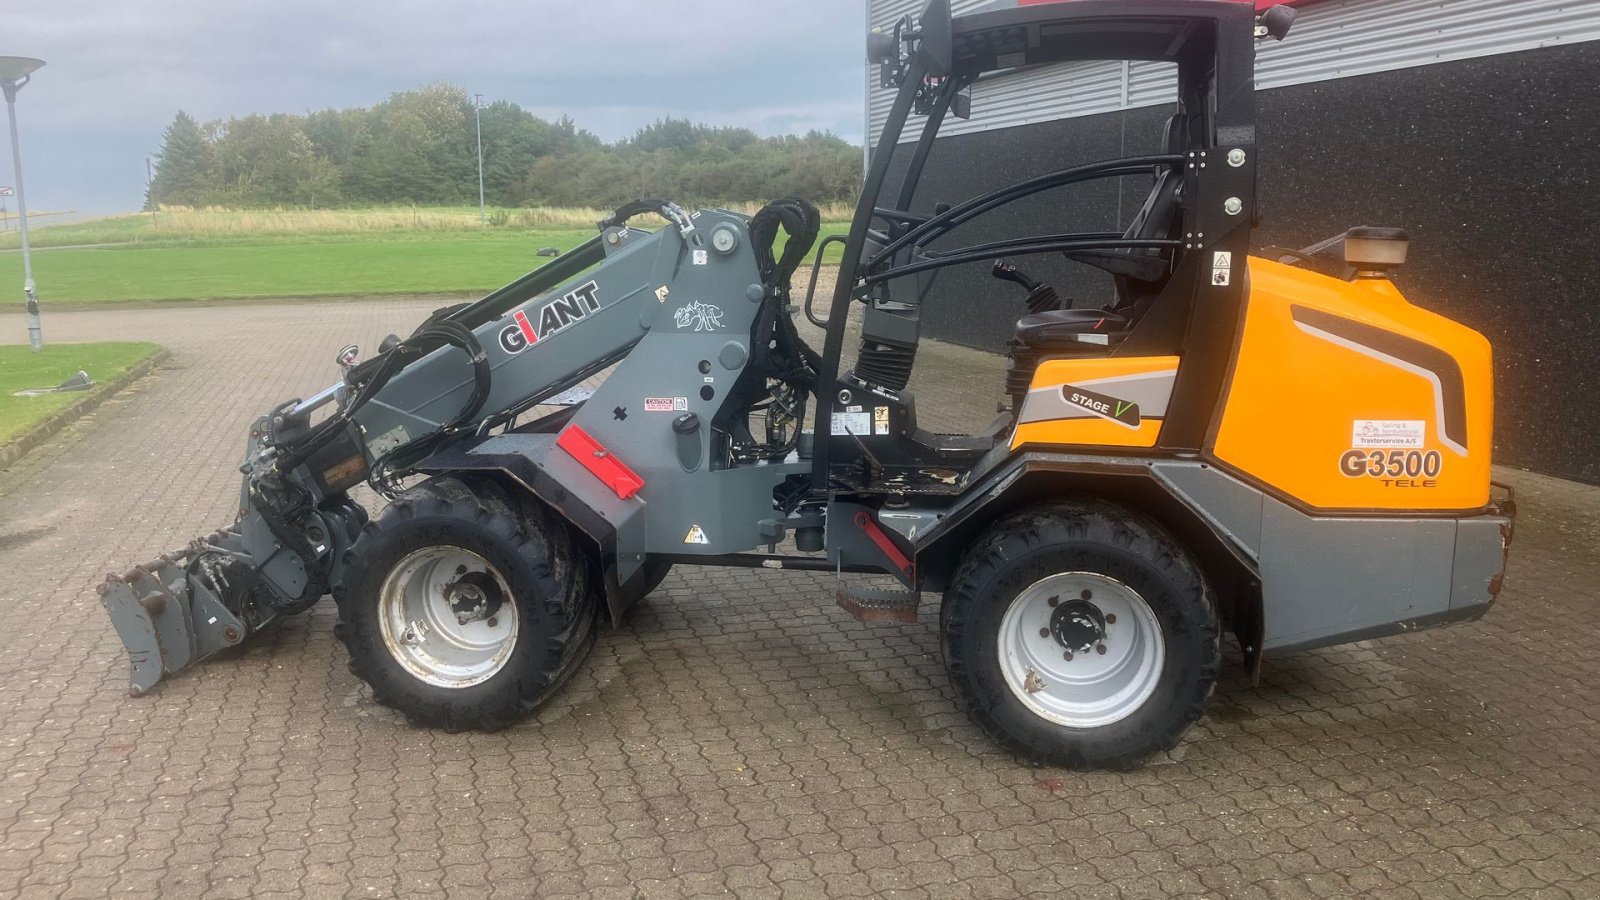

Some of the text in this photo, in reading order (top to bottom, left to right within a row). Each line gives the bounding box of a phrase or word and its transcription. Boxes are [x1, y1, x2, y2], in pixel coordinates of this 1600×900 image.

[1071, 393, 1136, 418] STAGE V
[1339, 449, 1442, 478] G3500
[1380, 479, 1437, 488] TELE
